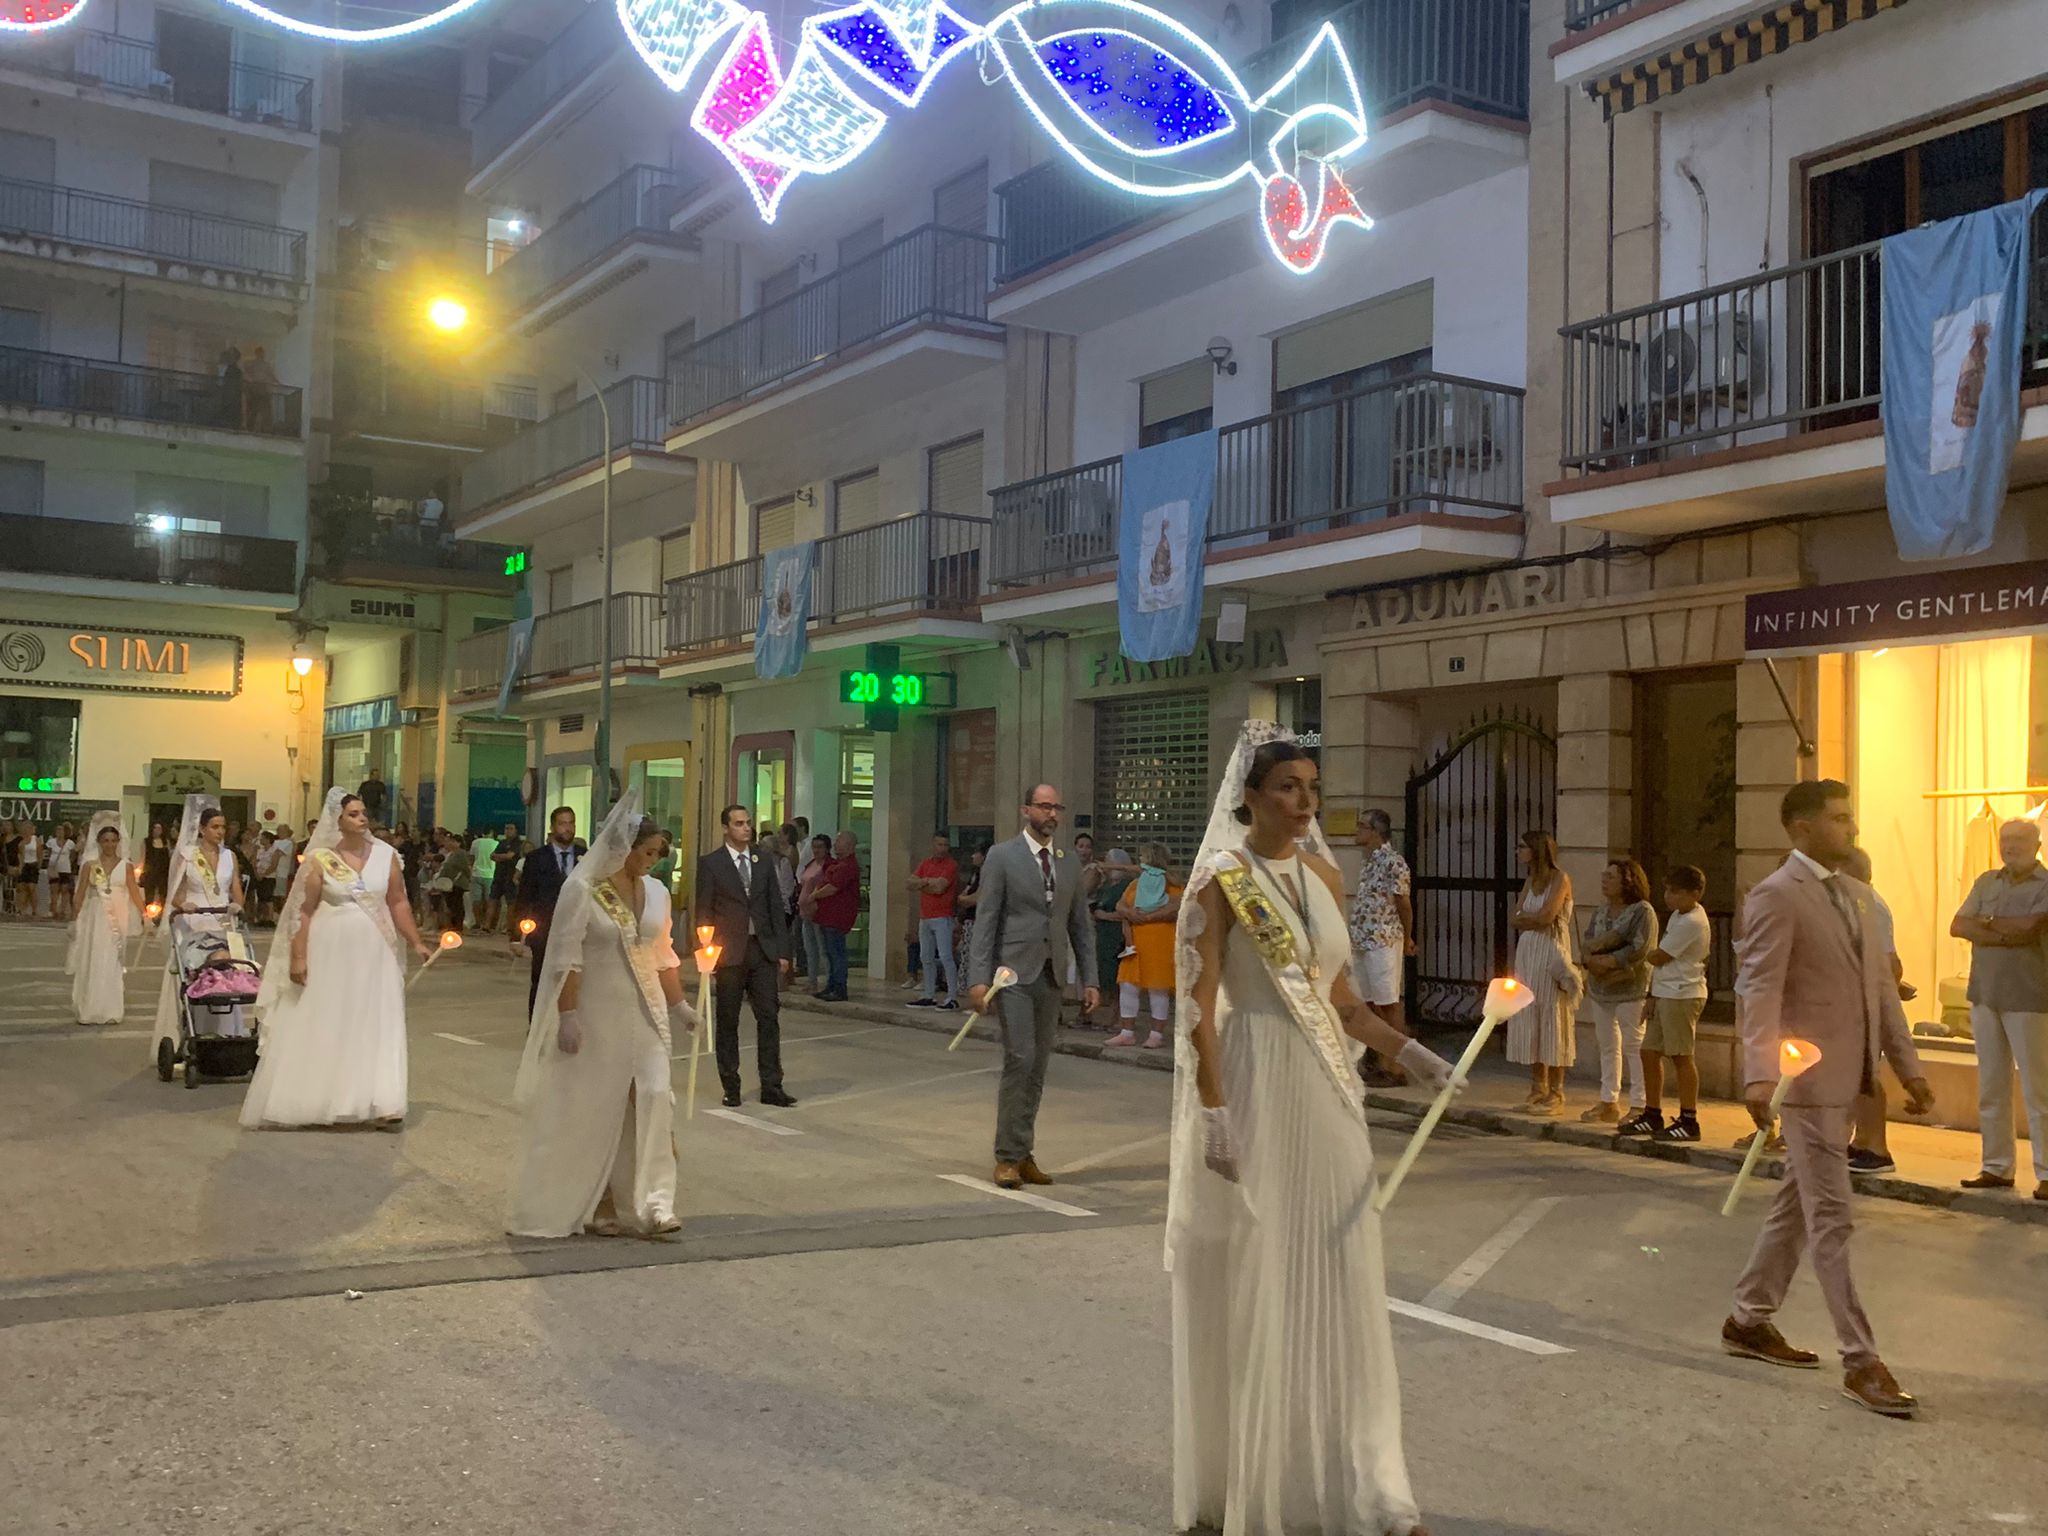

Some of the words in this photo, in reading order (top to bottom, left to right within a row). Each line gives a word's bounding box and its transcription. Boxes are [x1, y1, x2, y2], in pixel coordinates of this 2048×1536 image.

[1754, 603, 1881, 633] INFINITY
[849, 671, 879, 702] 20
[891, 674, 921, 705] 30
